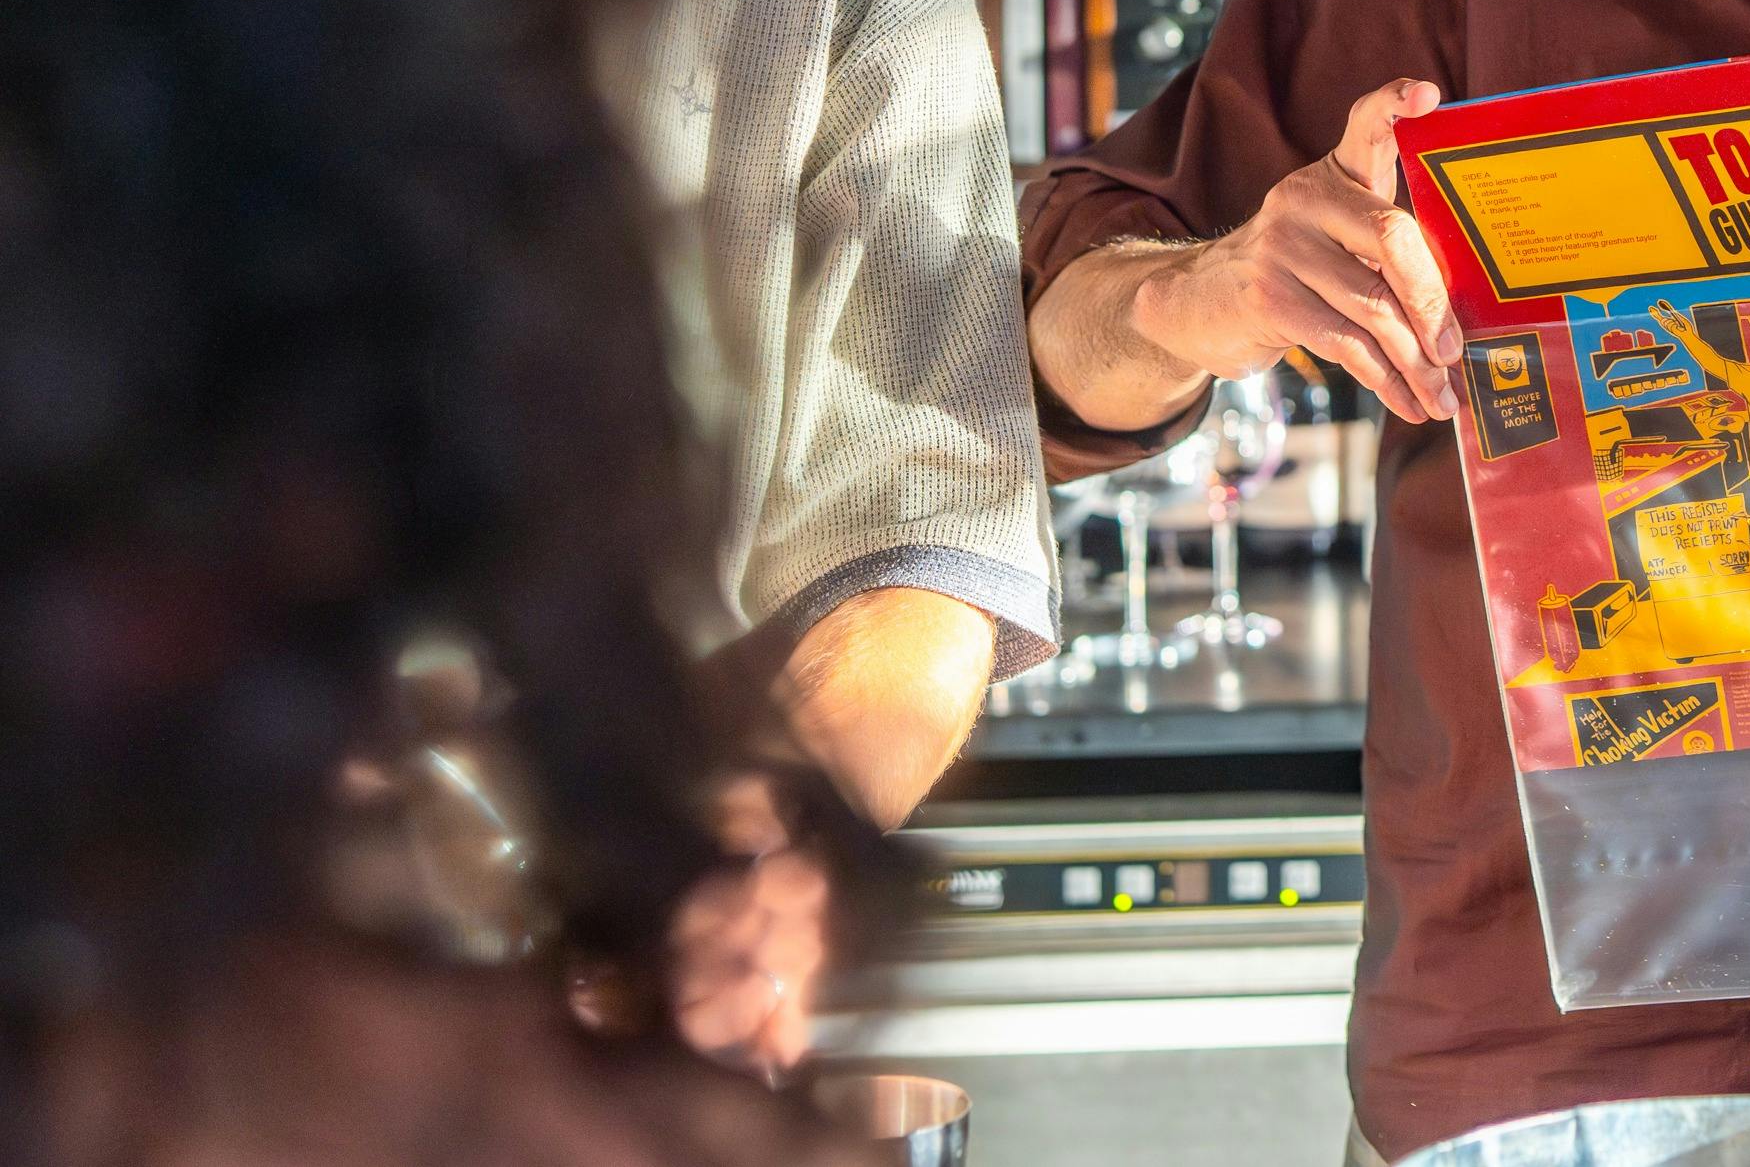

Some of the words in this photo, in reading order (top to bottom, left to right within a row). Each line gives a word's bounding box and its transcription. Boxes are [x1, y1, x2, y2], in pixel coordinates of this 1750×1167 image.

[1462, 173, 1481, 181] SIDE
[1540, 172, 1558, 181] goat
[1485, 195, 1521, 205] organism
[1490, 206, 1511, 214] thank
[1513, 204, 1527, 212] you
[1491, 221, 1511, 230] SIDE
[1511, 237, 1544, 247] interlude
[1546, 234, 1563, 242] train
[1565, 233, 1573, 241] of
[1574, 230, 1603, 240] thought
[1522, 246, 1539, 257] gets
[1541, 243, 1563, 254] heavy
[1565, 239, 1599, 250] featuring
[1601, 236, 1635, 247] gresham
[1636, 233, 1658, 244] taylor
[1519, 257, 1534, 265] thin
[1535, 254, 1559, 263] brown
[1494, 392, 1541, 408] EMPLOYEE
[1502, 408, 1513, 418] OF
[1518, 403, 1536, 413] THE
[1504, 412, 1542, 429] MONTH
[1645, 507, 1676, 524] THIS
[1680, 502, 1728, 520] REGISTER
[1687, 520, 1705, 533] NOT
[1708, 516, 1740, 532] PRINT
[1674, 534, 1732, 550] RECIEPTS
[1580, 709, 1602, 725] Help
[1583, 726, 1653, 767] Choking
[1636, 695, 1701, 734] Victim
[1591, 720, 1607, 732] For
